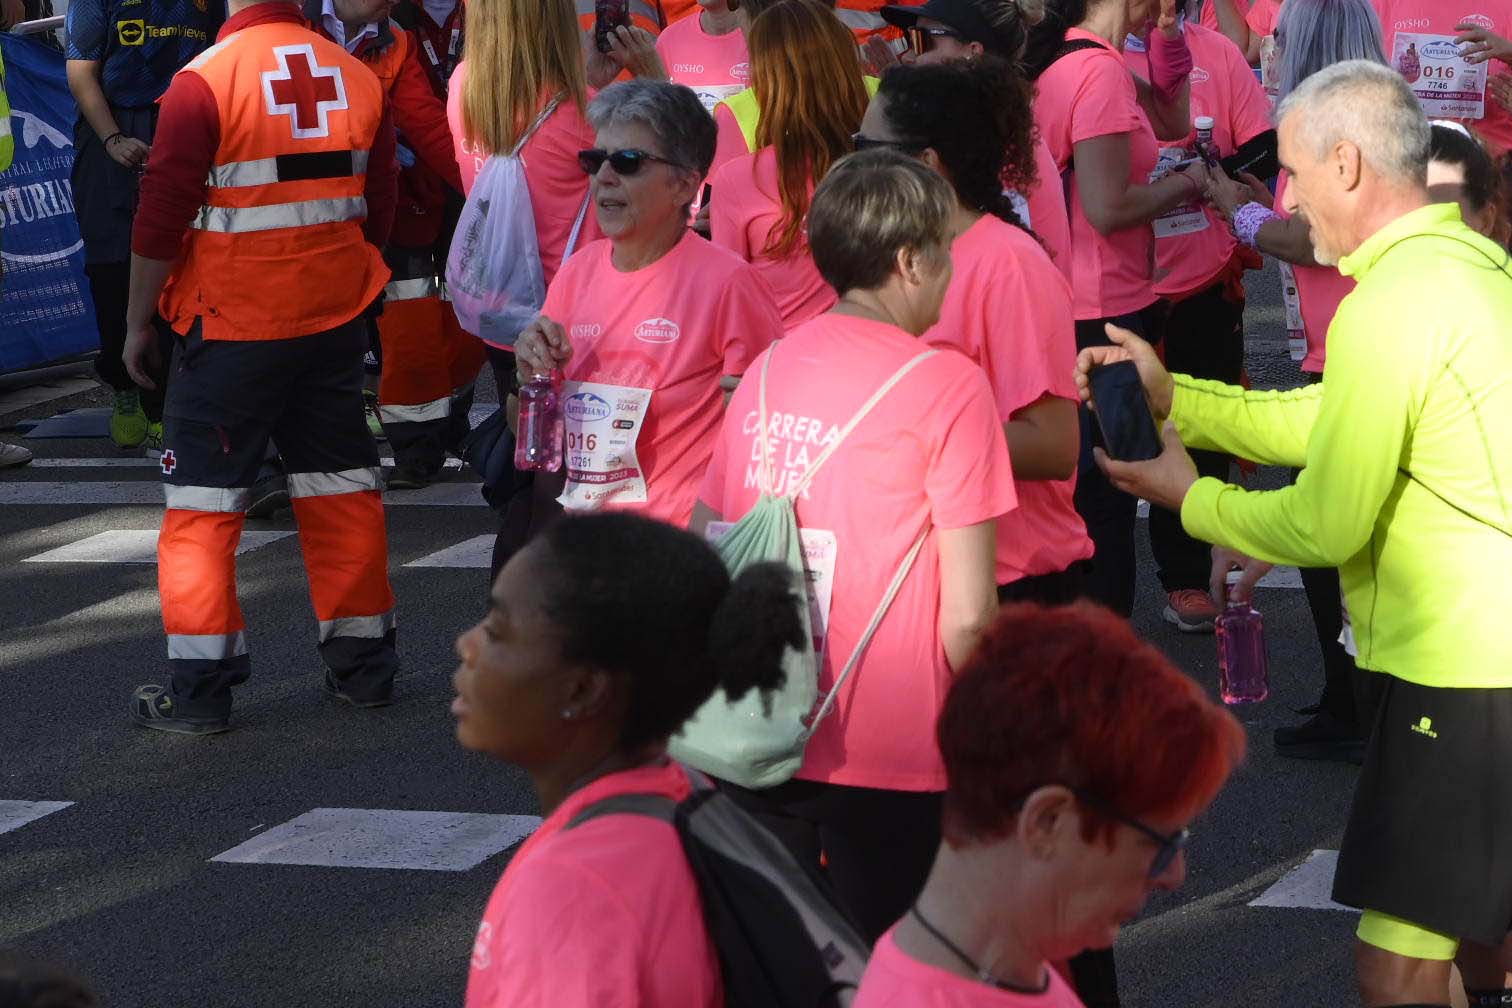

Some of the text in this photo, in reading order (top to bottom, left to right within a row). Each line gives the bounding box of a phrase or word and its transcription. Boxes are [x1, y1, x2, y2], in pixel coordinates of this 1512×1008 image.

[1395, 18, 1430, 30] OYSHO
[672, 63, 704, 74] OYSHO
[1423, 65, 1455, 79] 016
[1428, 81, 1448, 90] 7746
[1448, 103, 1477, 113] Santander
[568, 432, 598, 452] 016
[784, 442, 810, 469] LA
